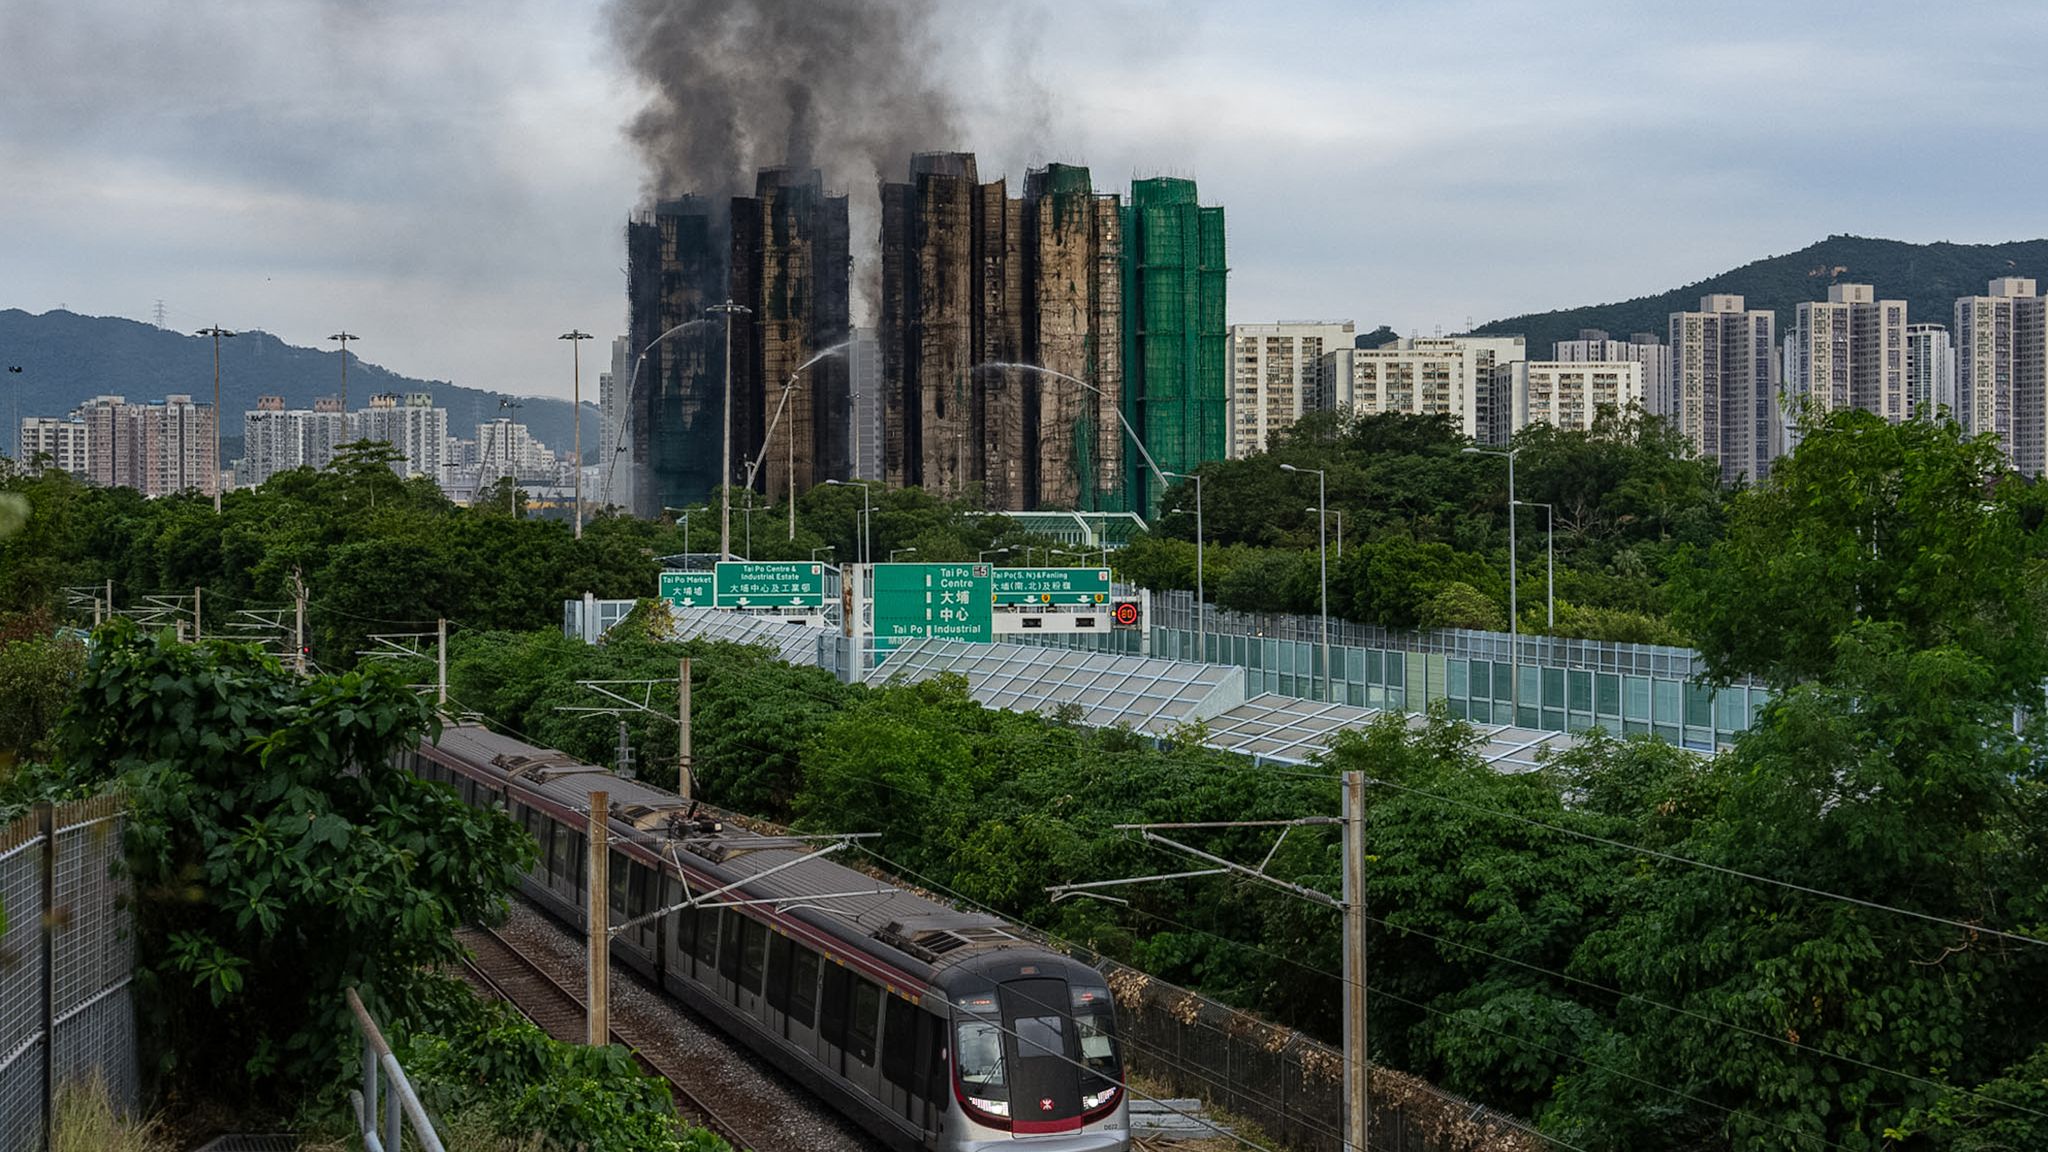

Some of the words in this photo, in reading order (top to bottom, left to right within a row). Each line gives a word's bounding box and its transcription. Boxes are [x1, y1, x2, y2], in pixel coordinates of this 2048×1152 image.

[940, 568, 954, 577] Tai
[956, 568, 969, 577] Po
[941, 578, 973, 588] Centre
[940, 590, 970, 605] 大埔
[940, 607, 969, 622] 中心
[1121, 609, 1133, 619] 80
[893, 624, 907, 634] Tai
[910, 624, 923, 634] Po
[933, 624, 981, 634] Industrial
